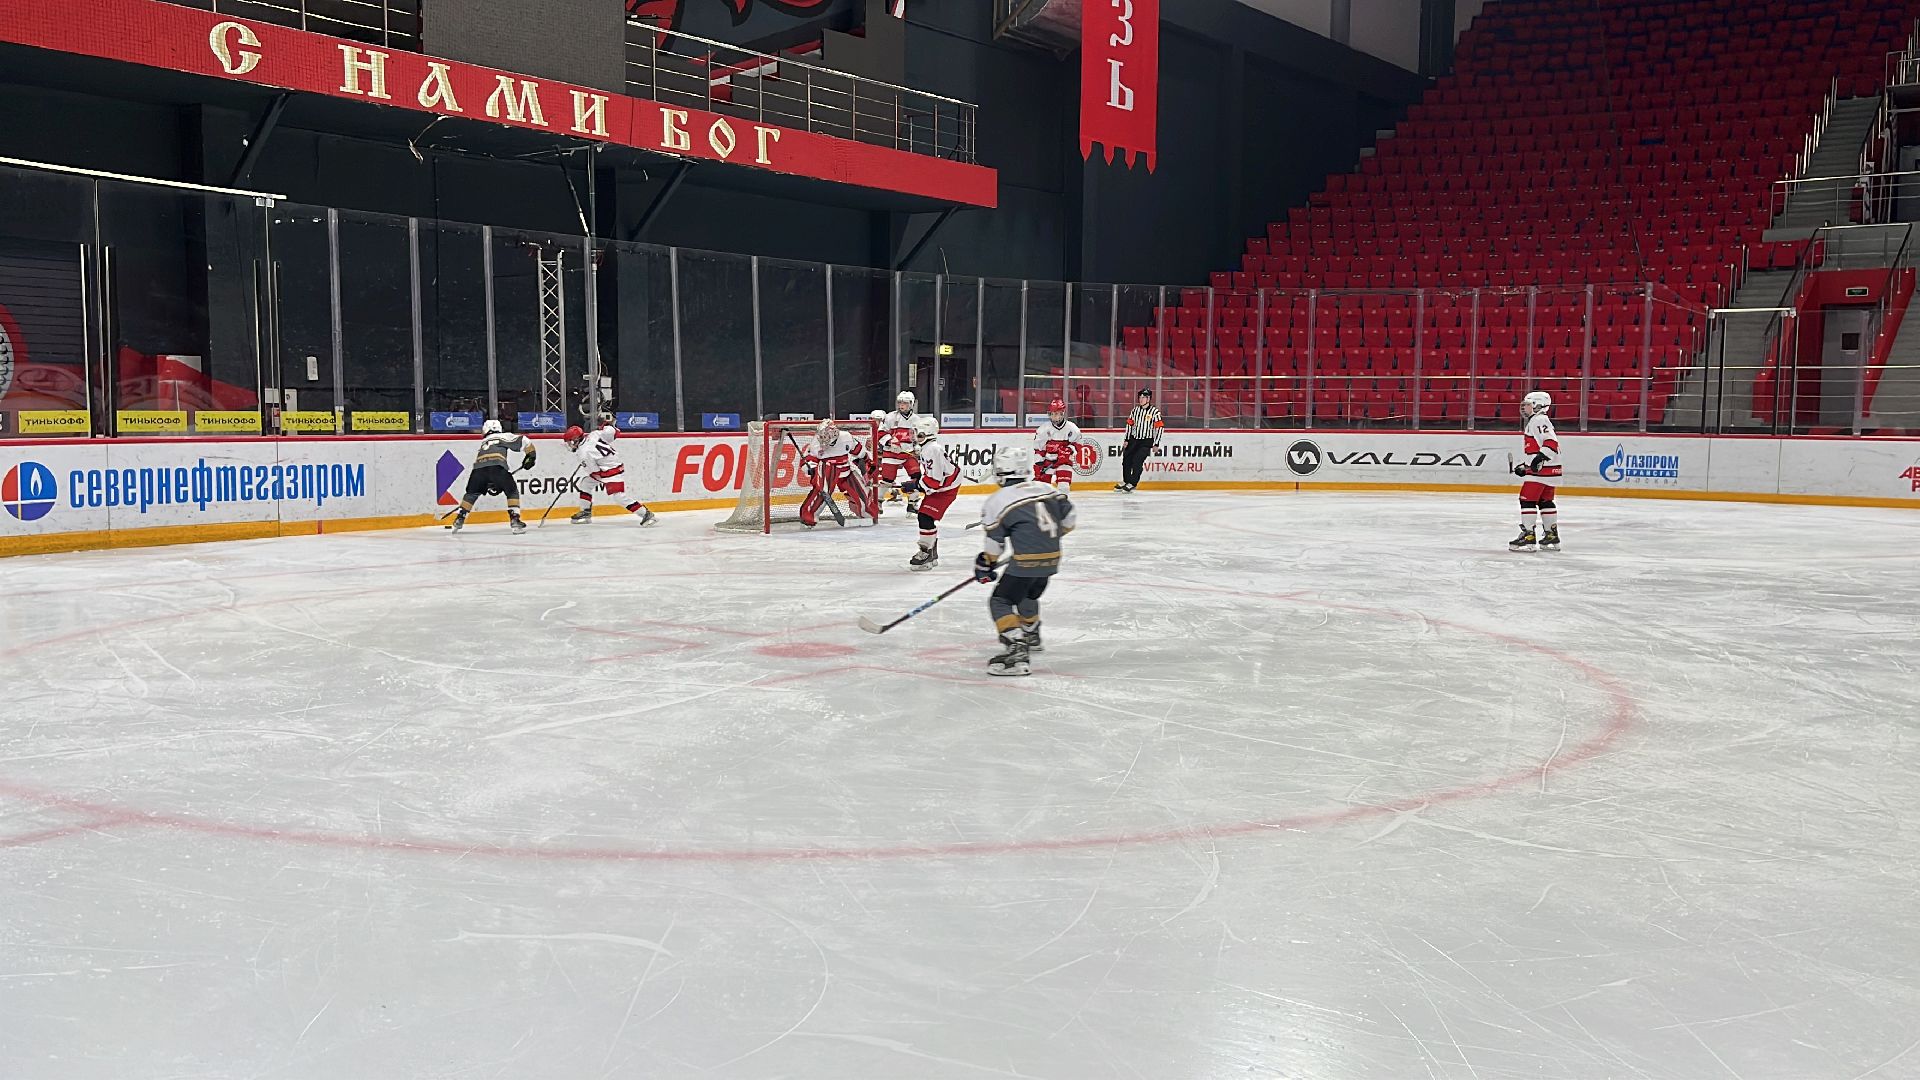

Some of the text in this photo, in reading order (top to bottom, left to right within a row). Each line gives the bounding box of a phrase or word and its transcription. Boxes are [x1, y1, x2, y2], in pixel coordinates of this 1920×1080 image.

[338, 44, 610, 137] НАМИ
[660, 107, 780, 165] БОГ
[25, 417, 85, 426] ТИНЬКОФФ
[122, 417, 181, 425] ТИНЬКОФФ
[201, 417, 256, 425] ТИНЬКОФФ
[285, 417, 336, 425] ТИНЬКОФФ
[356, 417, 405, 425] ТИНЬКОФФ
[1537, 425, 1549, 434] 12
[1172, 442, 1233, 458] ОНЛАЙН
[1326, 451, 1487, 467] VALDAI
[1625, 455, 1679, 469] ГАЗПРОМ
[1626, 469, 1678, 478] ТРАНСГАЗ
[1625, 478, 1678, 486] МОСКВА
